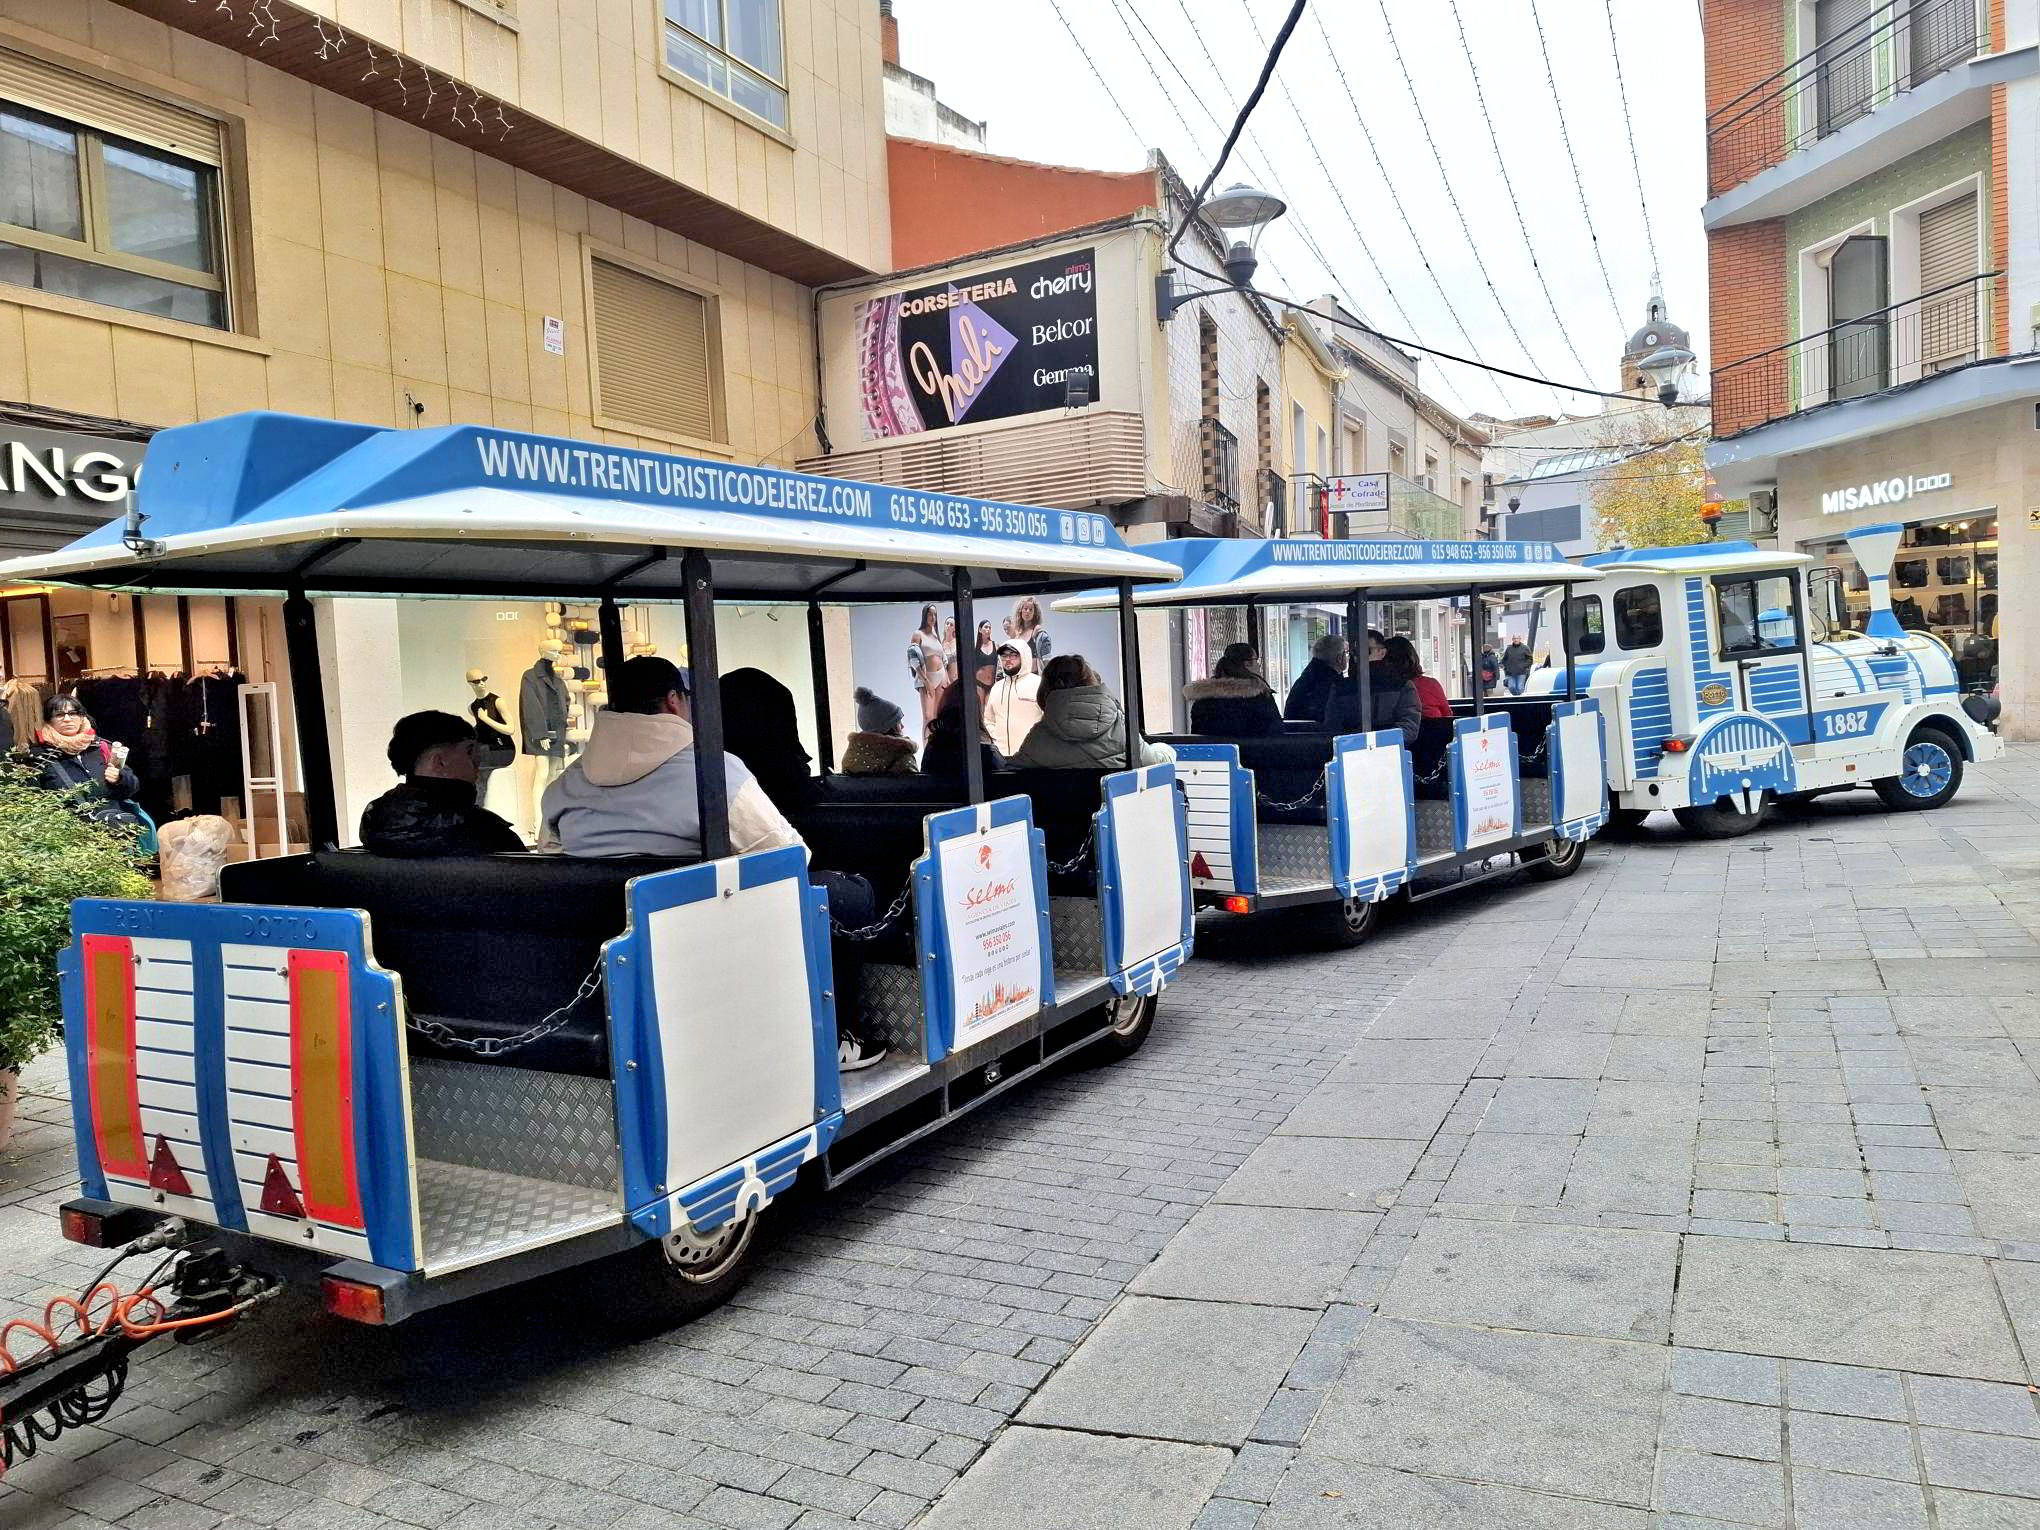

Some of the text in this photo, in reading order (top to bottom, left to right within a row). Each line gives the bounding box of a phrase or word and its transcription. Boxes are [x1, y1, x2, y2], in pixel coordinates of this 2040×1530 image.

[900, 277, 1017, 318] CORSETERIA
[1031, 271, 1092, 299] cherry
[1031, 317, 1093, 346] Belcor
[476, 437, 872, 519] WWW.TRENTURISTICODEJEREZ.COM
[890, 494, 917, 523] 615
[920, 498, 945, 527] 948
[948, 502, 970, 529] 653
[981, 505, 1002, 532] 956
[1005, 509, 1025, 536] 350
[1027, 513, 1048, 537] 056
[1823, 478, 1905, 515] MISAKO
[1272, 543, 1423, 561] WWW.TRENTURISTICODEJEREZ.COM
[1431, 543, 1444, 560] 615
[1446, 544, 1459, 560] 948
[1460, 544, 1474, 560] 653
[1478, 544, 1491, 560] 956
[1491, 544, 1504, 560] 350
[1504, 544, 1517, 560] 056
[1823, 711, 1868, 737] 1887
[982, 937, 993, 951] 956
